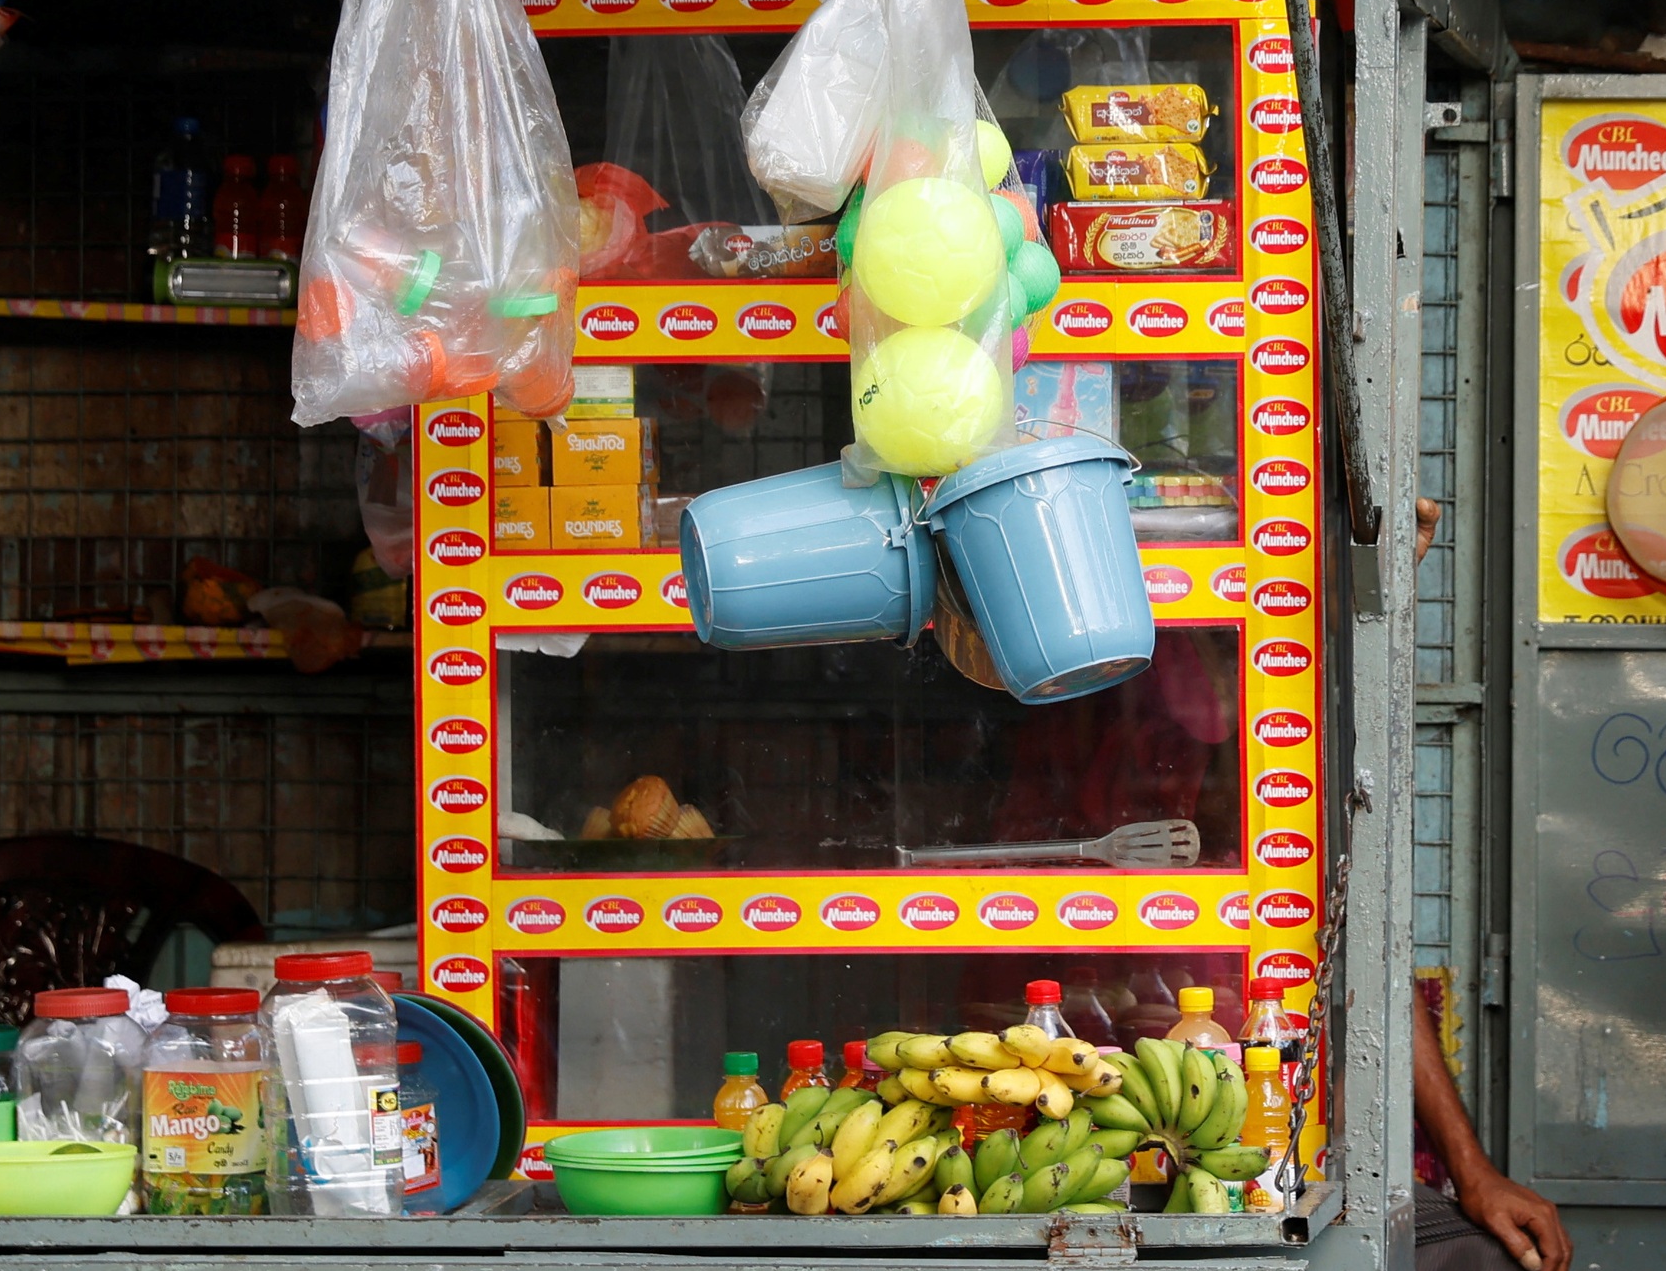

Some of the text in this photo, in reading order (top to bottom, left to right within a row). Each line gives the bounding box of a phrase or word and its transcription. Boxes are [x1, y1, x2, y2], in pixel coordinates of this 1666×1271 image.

[1598, 126, 1637, 145] CBL
[1255, 169, 1303, 186] Munchee
[1110, 216, 1155, 227] Maliban
[1255, 228, 1305, 246] Munchee
[1257, 289, 1305, 306] Munchee
[587, 315, 635, 332] Munchee
[665, 315, 713, 332] Munchee
[744, 314, 792, 331] Munchee
[1060, 312, 1108, 329] Munchee
[1136, 312, 1184, 329] Munchee
[1596, 396, 1635, 414] CBL
[1258, 410, 1306, 427] Munchee
[433, 421, 481, 438] Munchee
[567, 434, 625, 451] ROUNDIES
[1575, 464, 1596, 496] A
[565, 520, 624, 538] ROUNDIES
[1259, 531, 1307, 548] Munchee
[435, 541, 483, 558] Munchee
[512, 585, 560, 602] Munchee
[590, 584, 638, 601] Munchee
[1259, 651, 1307, 668] Munchee
[435, 660, 483, 677] Munchee
[437, 788, 485, 805] Munchee
[1261, 782, 1309, 799] Munchee
[438, 908, 486, 925] Munchee
[514, 909, 562, 926] Munchee
[592, 908, 640, 925] Munchee
[671, 907, 719, 924] Munchee
[749, 906, 797, 923] Munchee
[828, 906, 876, 923] Munchee
[907, 905, 955, 922] Munchee
[986, 905, 1034, 922] Munchee
[1066, 905, 1114, 922] Munchee
[1147, 904, 1195, 921] Munchee
[1262, 902, 1310, 919] Munchee
[149, 1114, 220, 1140] Mango
